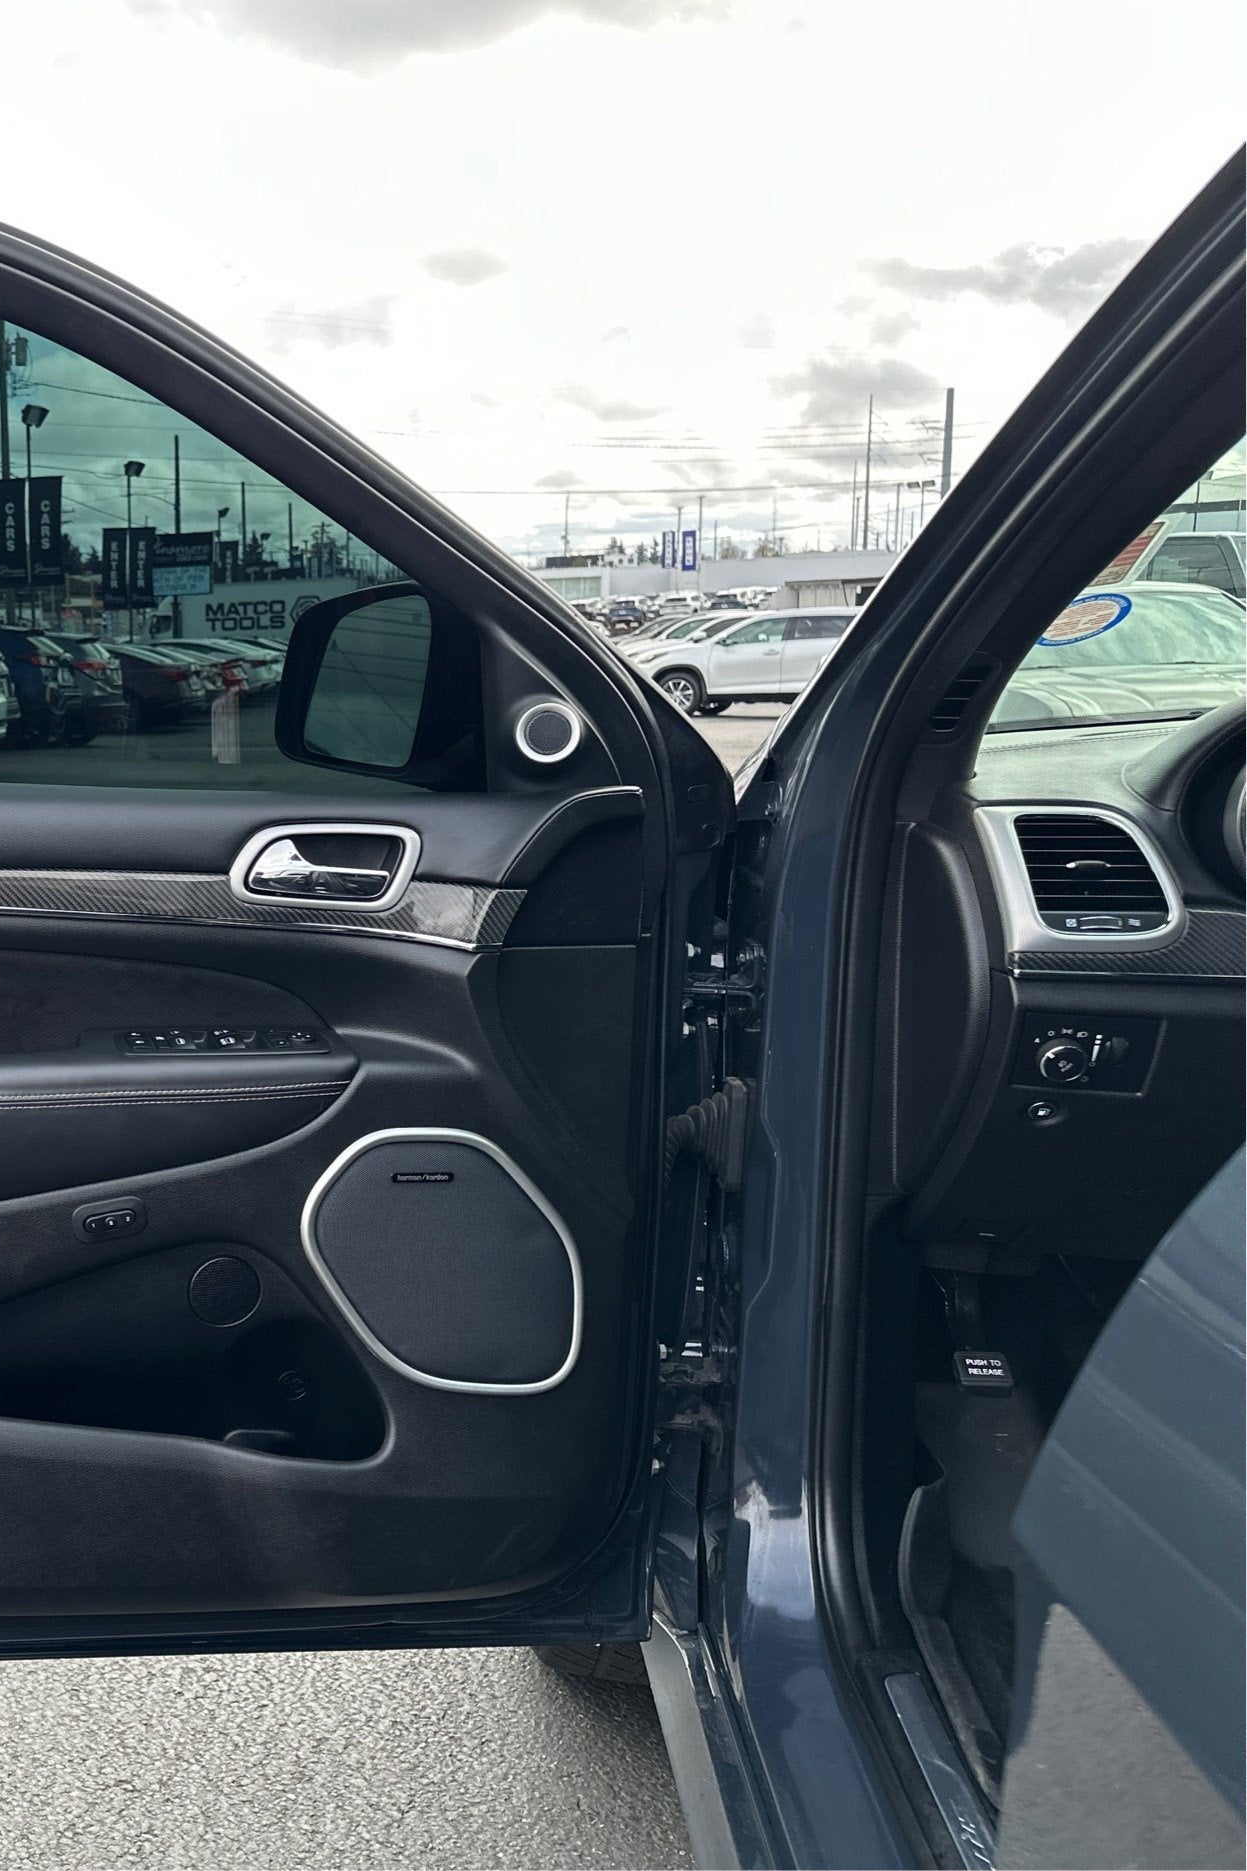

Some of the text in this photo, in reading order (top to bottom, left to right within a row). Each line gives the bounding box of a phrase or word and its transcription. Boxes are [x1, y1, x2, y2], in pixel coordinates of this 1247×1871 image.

[4, 502, 15, 552] CARS
[40, 500, 51, 550] CARS
[110, 541, 119, 589] ENTER
[136, 540, 147, 588] ENTER
[205, 600, 286, 618] MATCO
[205, 615, 285, 632] TOOLS
[965, 1358, 1002, 1367] PUSH TO
[967, 1368, 1004, 1376] RELEASE
